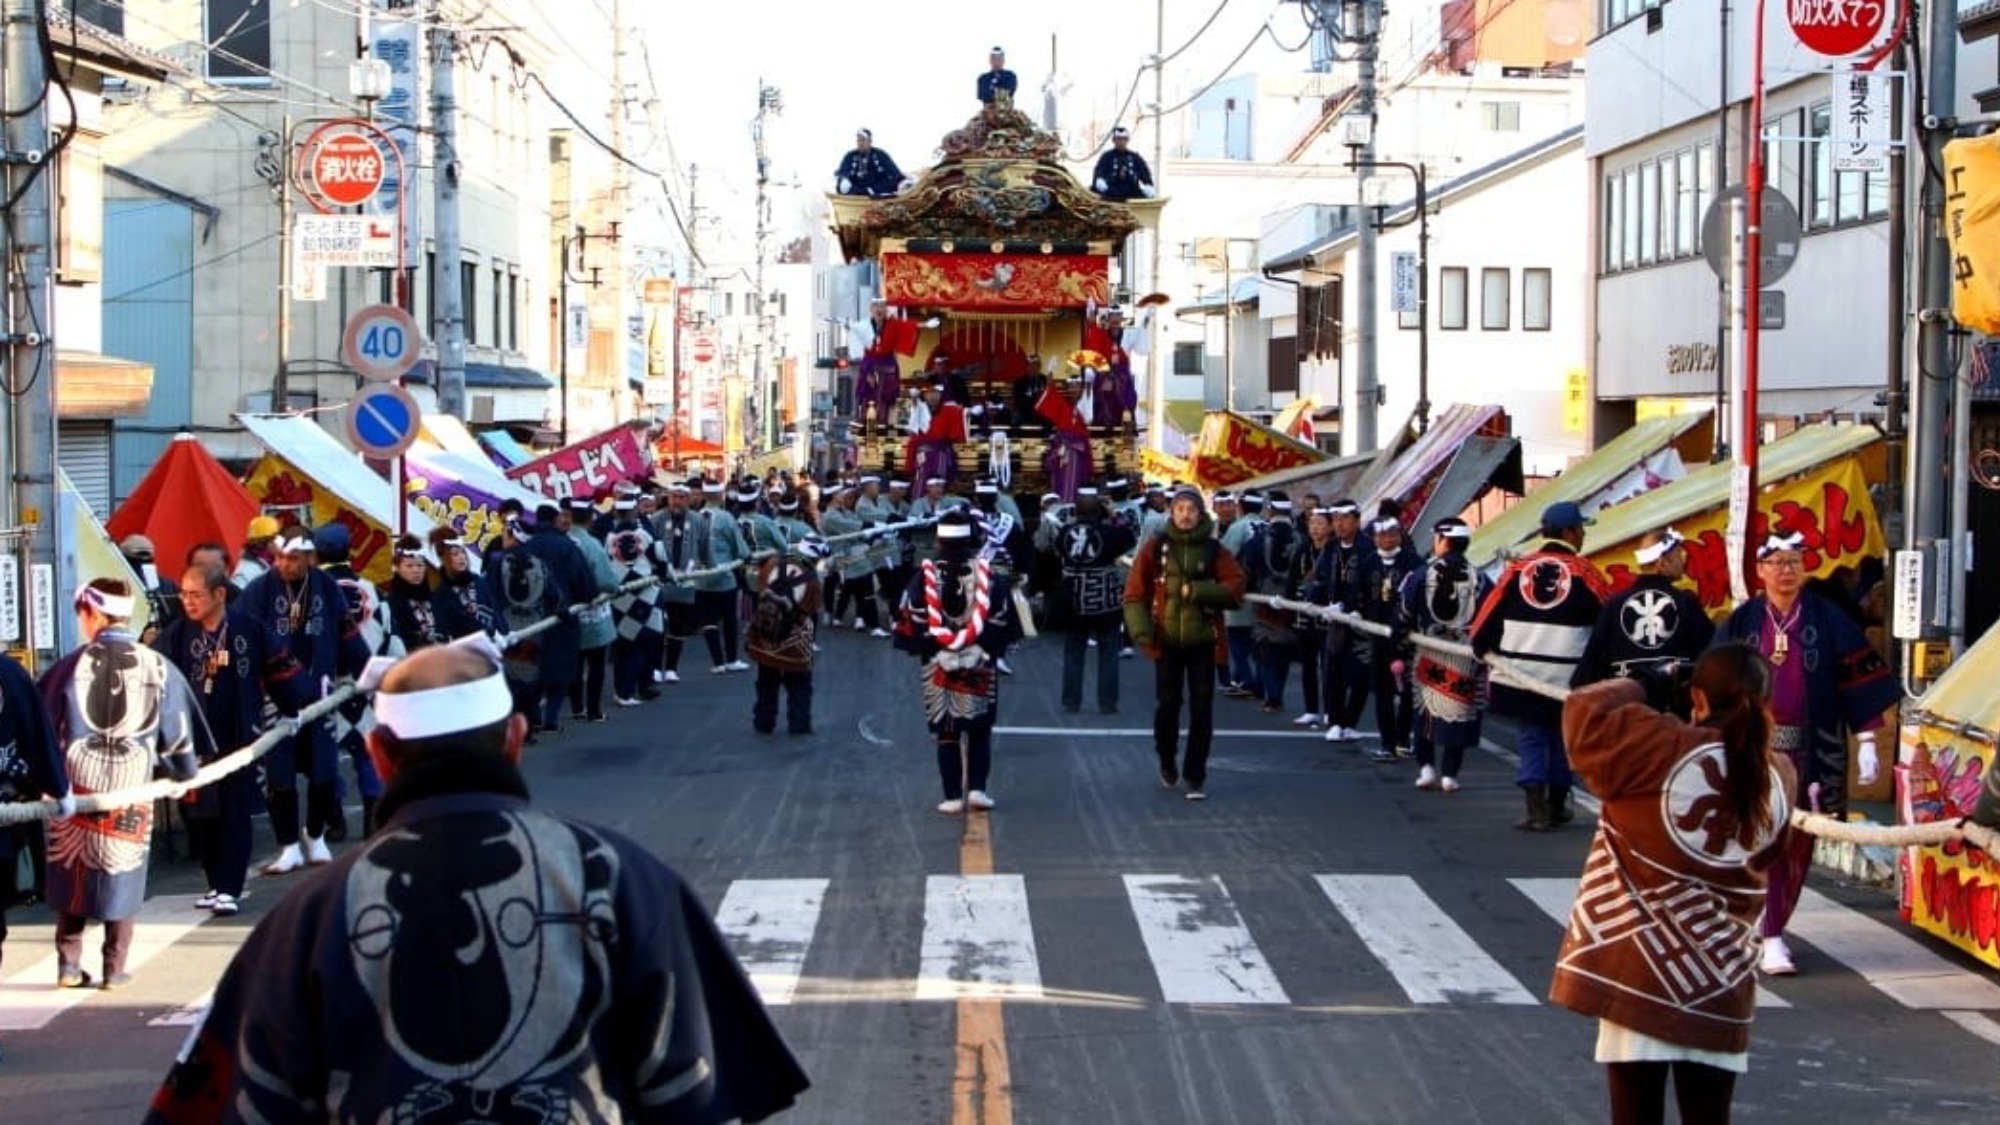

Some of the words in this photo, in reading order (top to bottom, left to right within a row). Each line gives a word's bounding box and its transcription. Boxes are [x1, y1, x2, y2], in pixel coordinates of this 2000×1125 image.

[318, 155, 377, 183] 消火栓
[362, 326, 402, 359] 40
